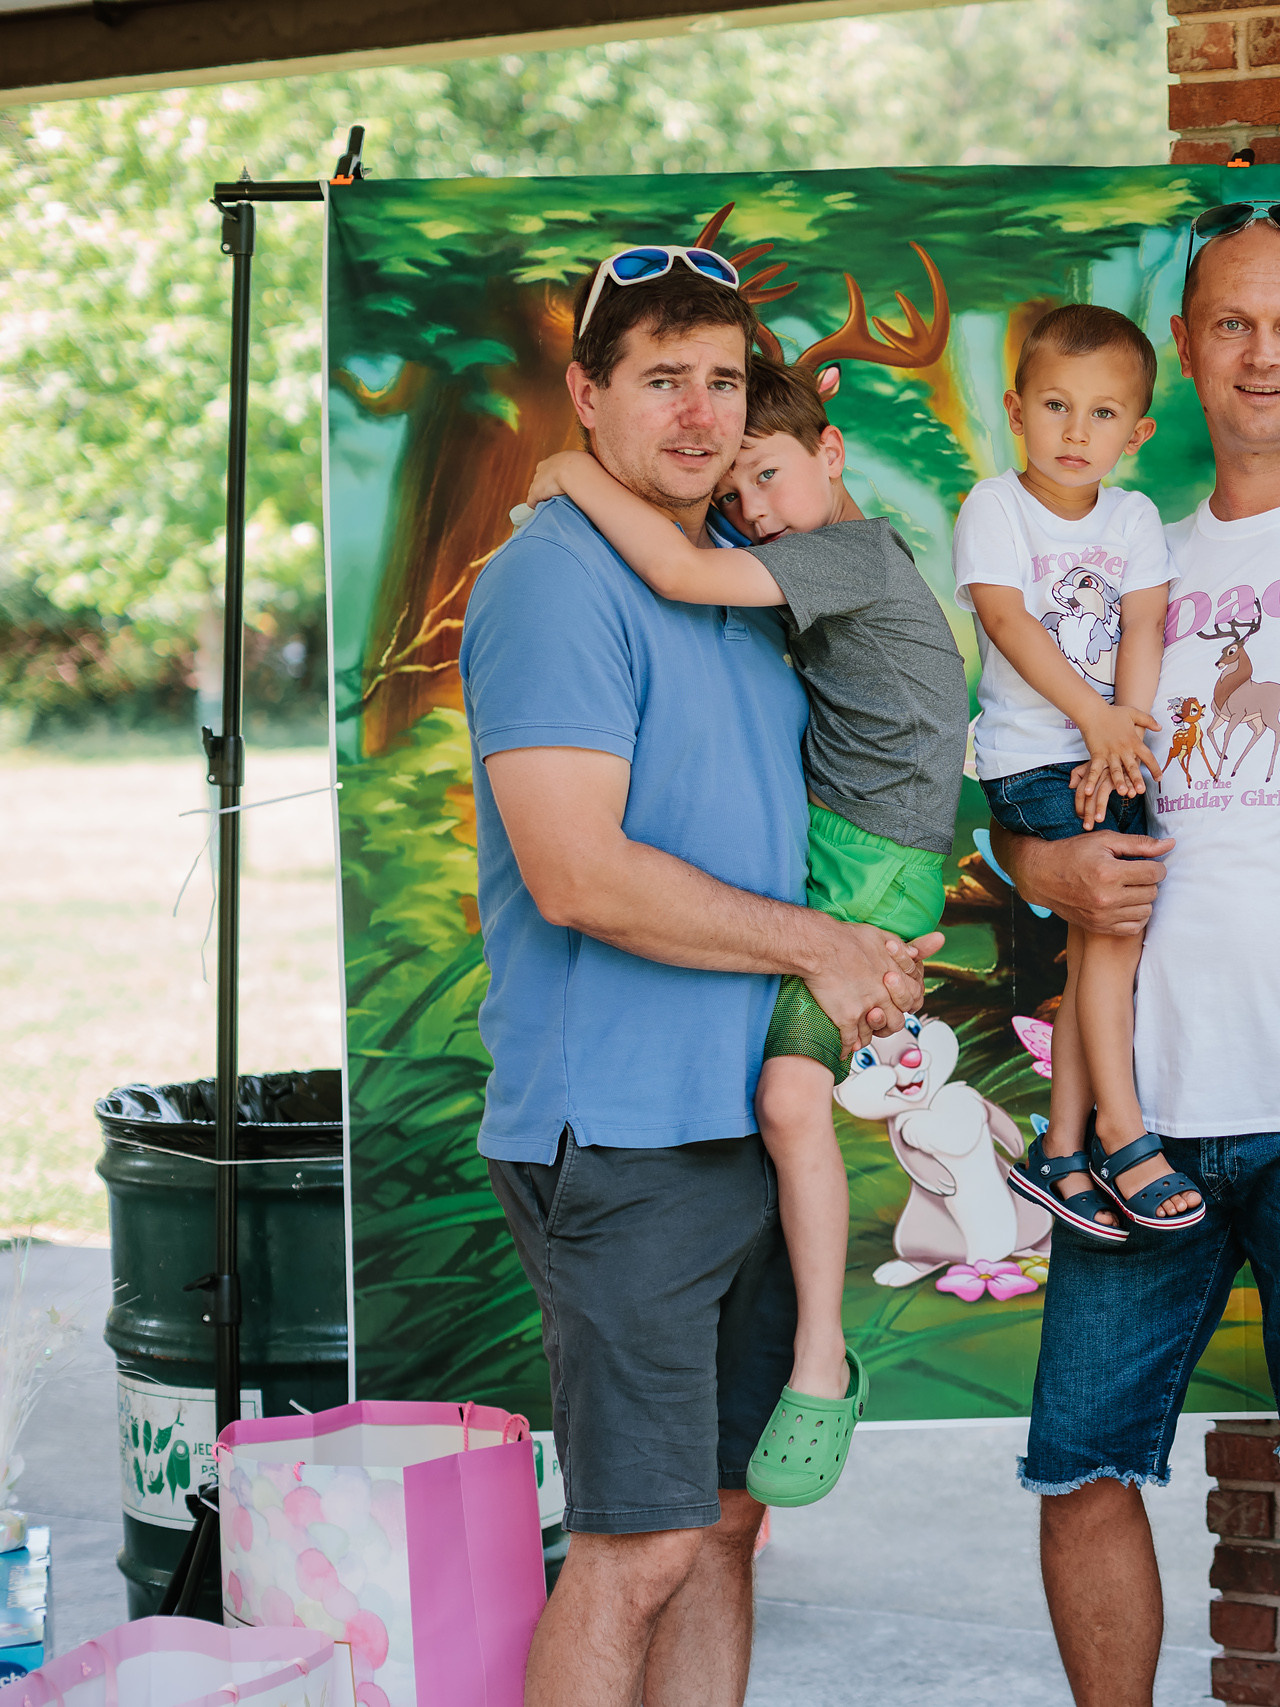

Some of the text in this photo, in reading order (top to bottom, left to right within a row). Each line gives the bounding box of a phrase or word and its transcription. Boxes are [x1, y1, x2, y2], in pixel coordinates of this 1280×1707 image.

[1194, 779, 1232, 791] Of the
[1156, 791, 1235, 815] Birthday
